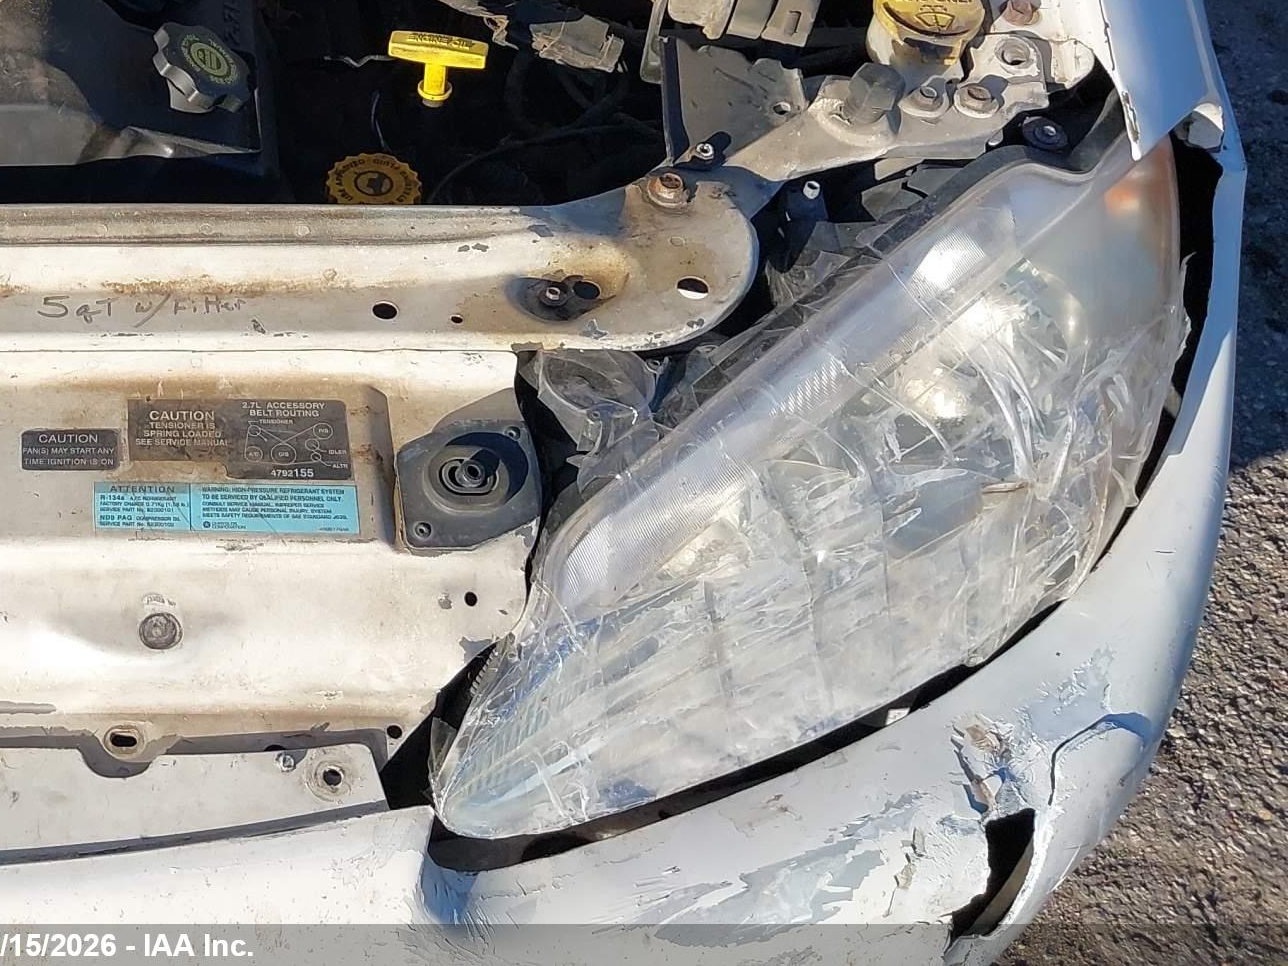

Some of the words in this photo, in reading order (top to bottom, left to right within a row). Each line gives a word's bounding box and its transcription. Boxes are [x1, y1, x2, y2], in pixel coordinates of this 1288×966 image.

[149, 410, 215, 421] CAUTION
[38, 434, 98, 443] CAUTION
[271, 469, 314, 477] 4792155
